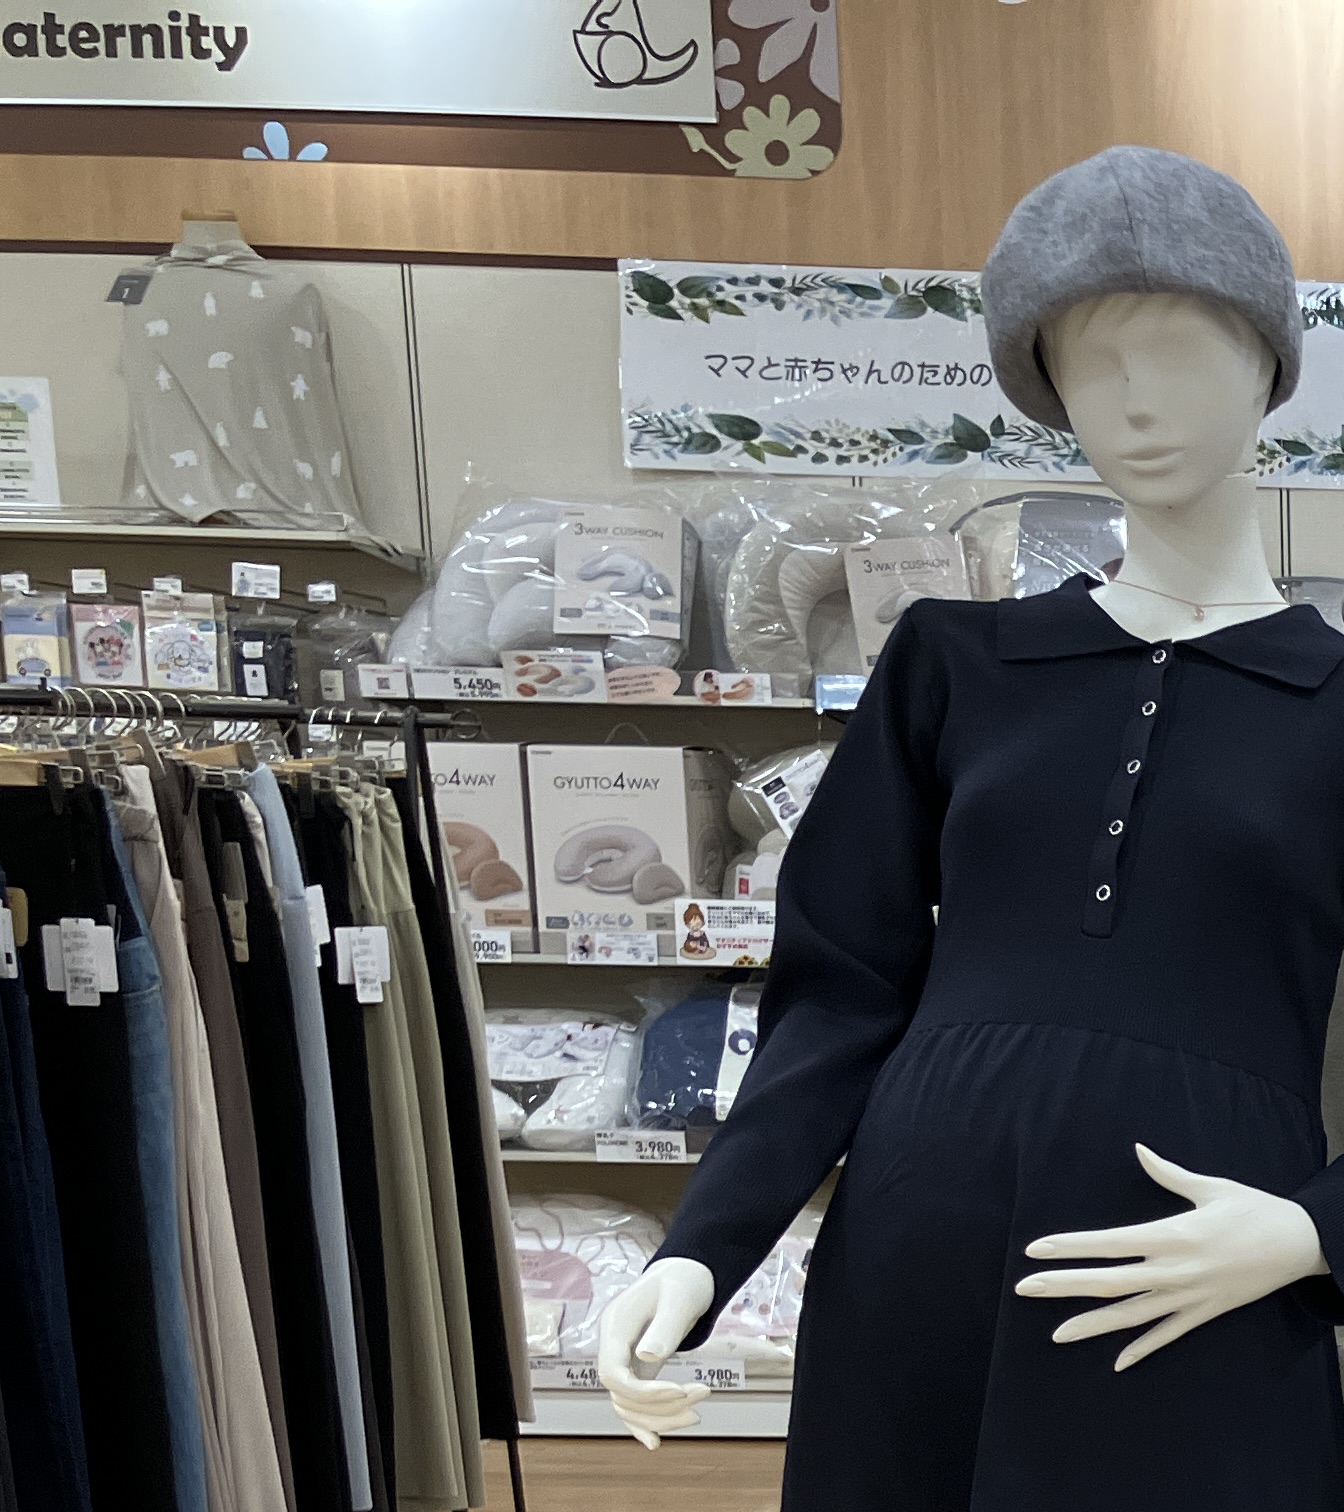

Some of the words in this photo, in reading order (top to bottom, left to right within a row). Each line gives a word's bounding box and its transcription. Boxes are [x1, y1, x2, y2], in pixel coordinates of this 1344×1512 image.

[2, 10, 249, 72] aternity
[703, 353, 993, 388] ママと赤ちゃんのための
[611, 526, 665, 539] CUSHION
[863, 559, 898, 573] 3WAY
[900, 557, 951, 571] CUSHION
